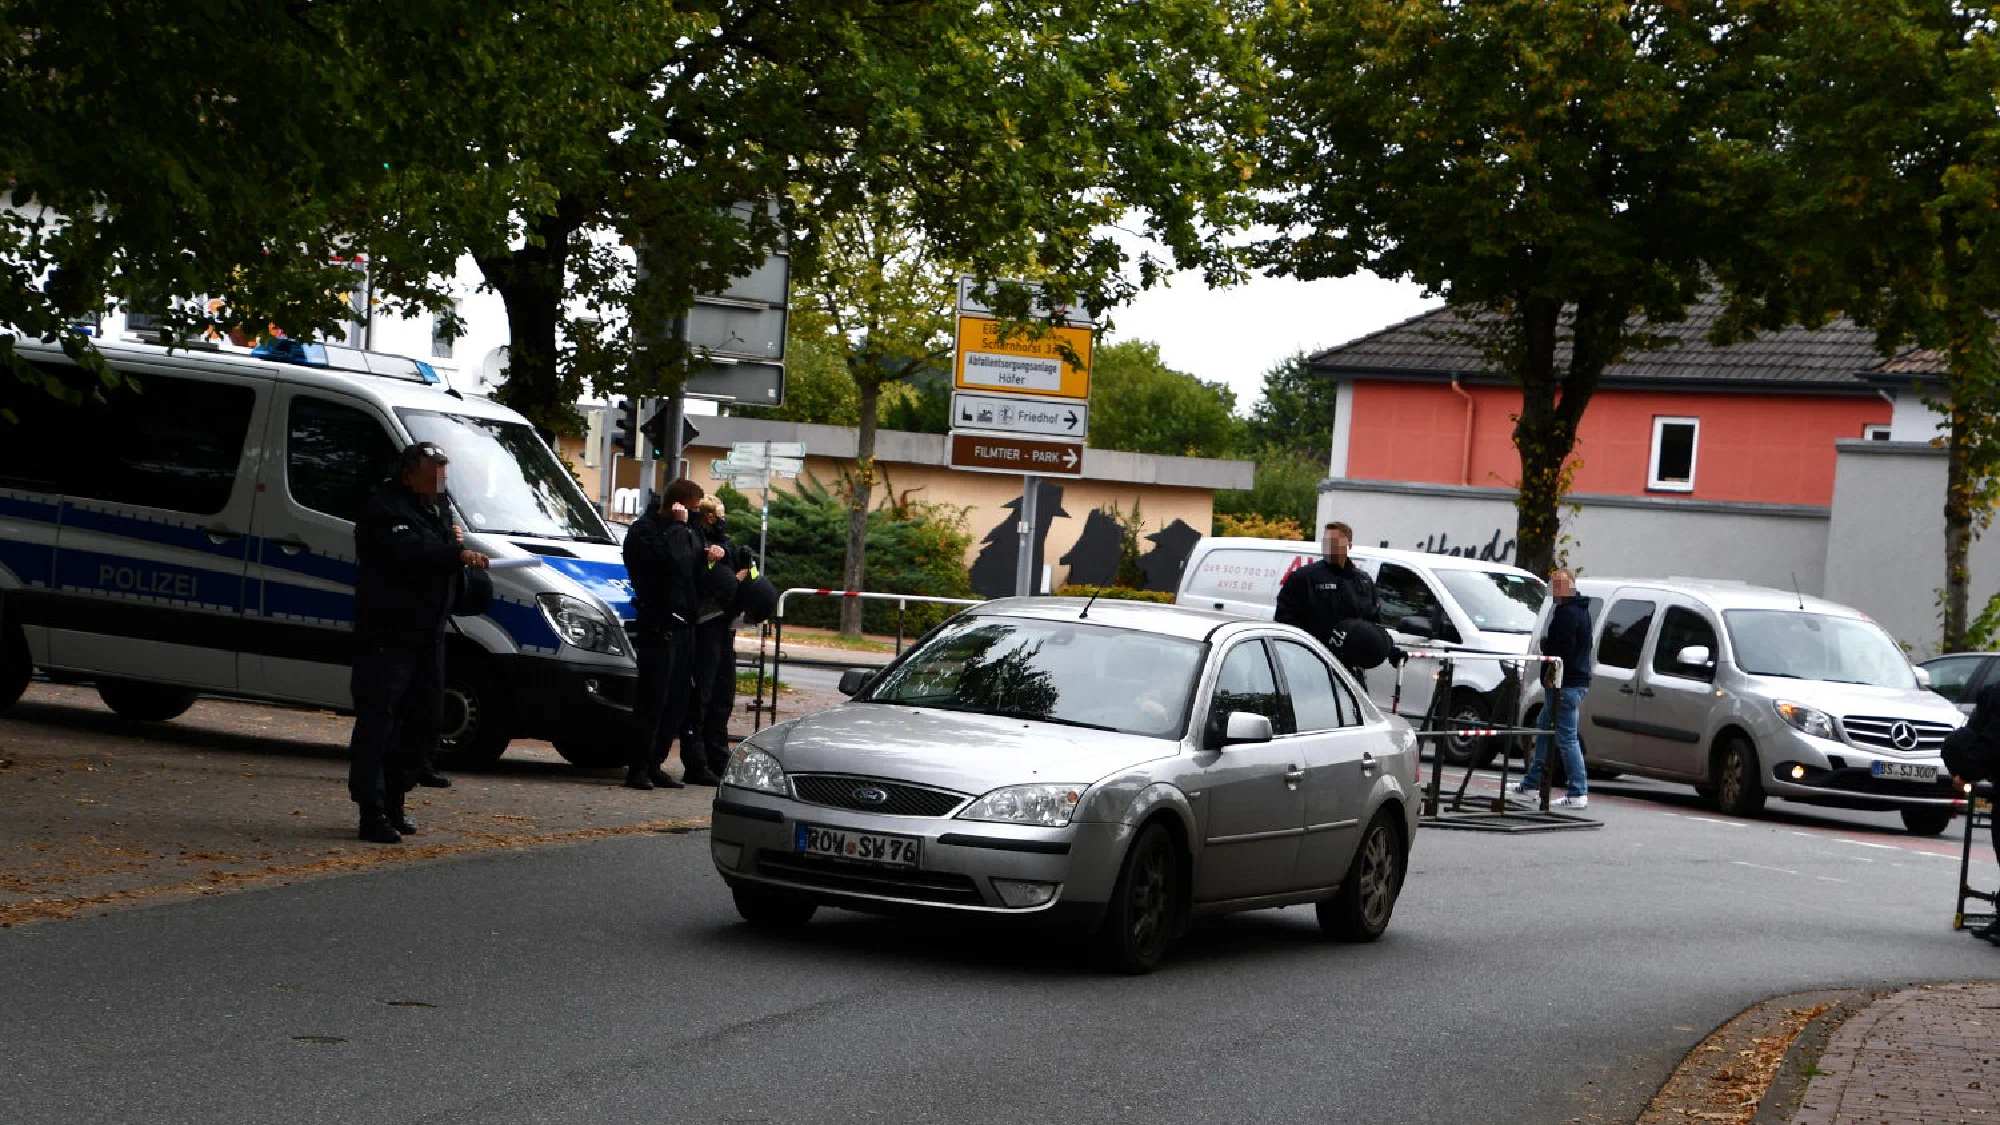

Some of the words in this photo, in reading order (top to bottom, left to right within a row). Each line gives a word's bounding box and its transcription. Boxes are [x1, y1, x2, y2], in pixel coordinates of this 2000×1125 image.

[1019, 410, 1059, 424] Friedhof
[975, 446, 1020, 460] FILMTIER
[1033, 450, 1059, 462] PARK
[99, 564, 197, 596] POLIZEI
[807, 829, 845, 855] ROW
[859, 836, 885, 859] SW
[890, 840, 915, 863] 76
